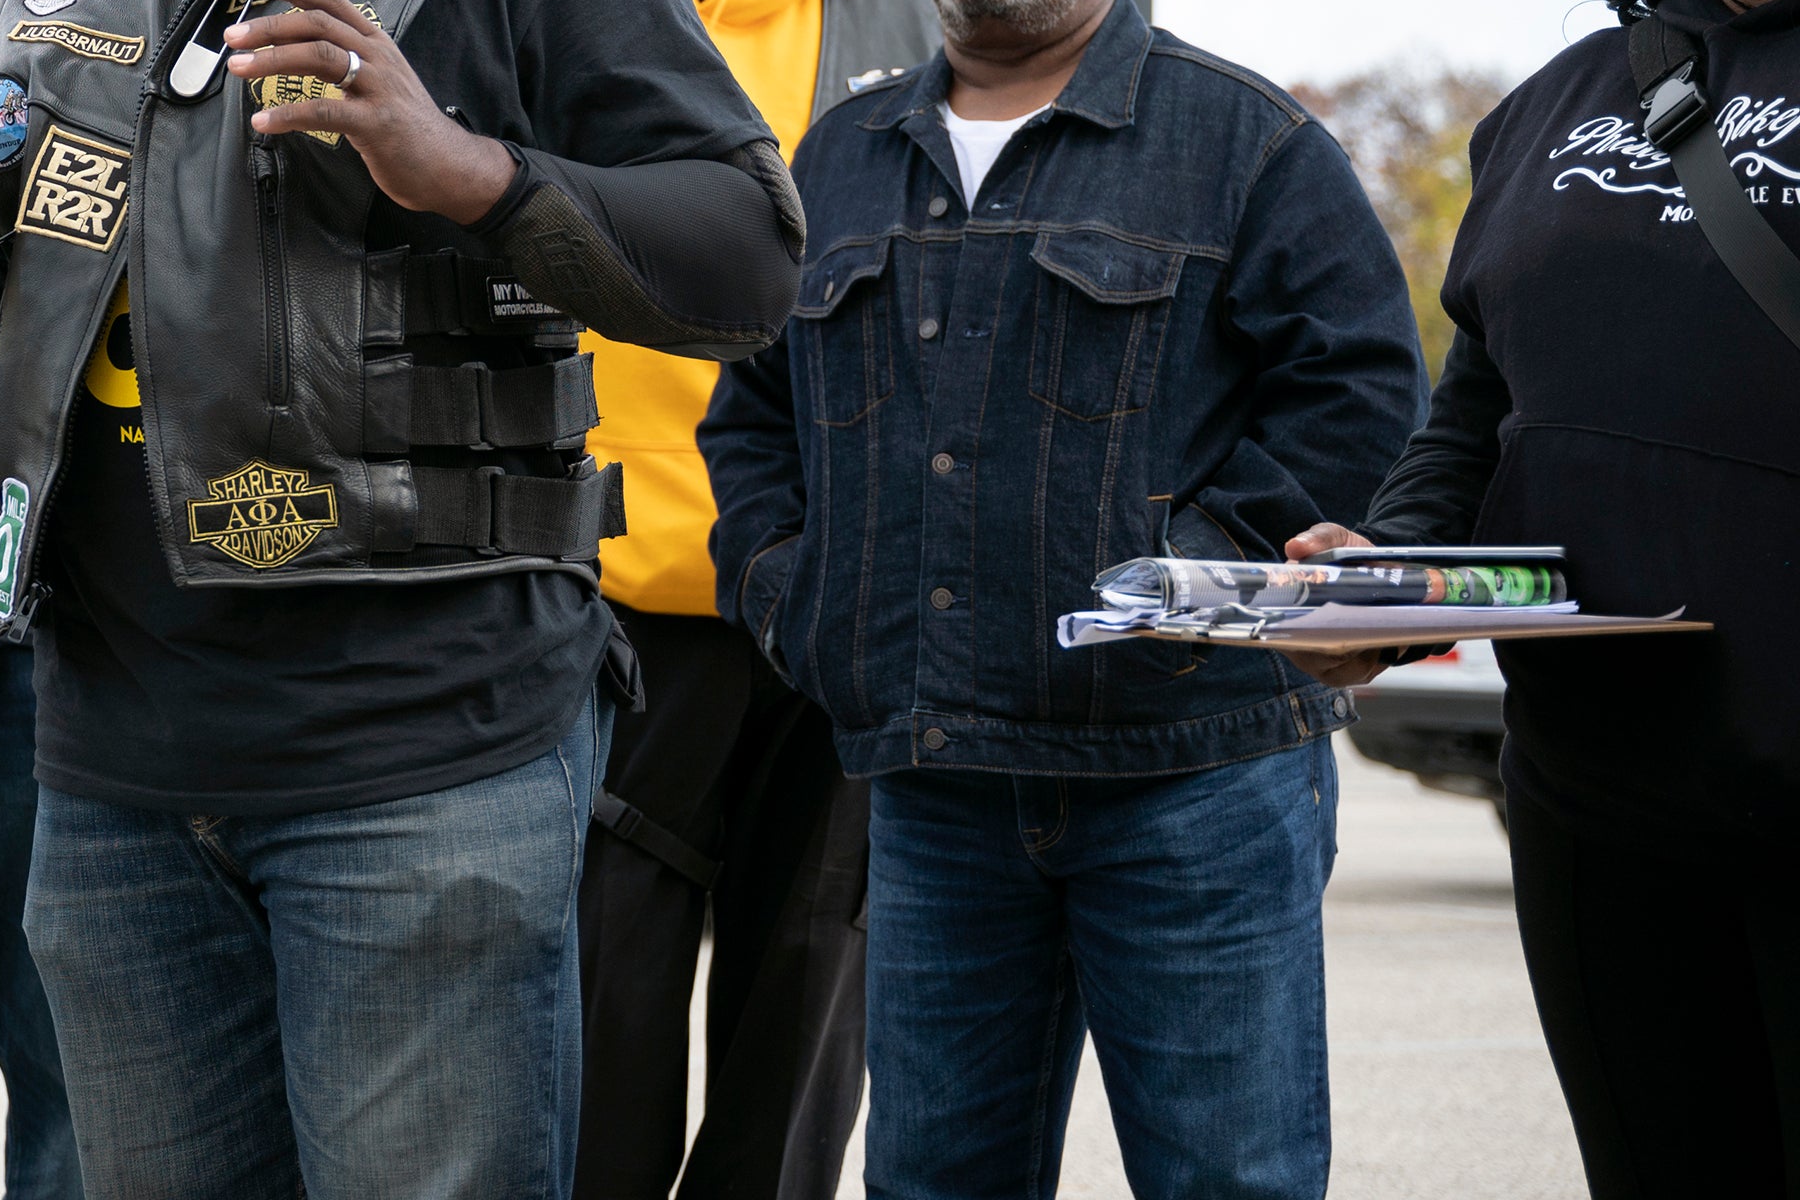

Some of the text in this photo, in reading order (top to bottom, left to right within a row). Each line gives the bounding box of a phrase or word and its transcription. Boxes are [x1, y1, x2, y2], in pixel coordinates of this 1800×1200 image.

[19, 25, 137, 59] JUGG3RNAUT
[39, 141, 128, 200] E2L
[25, 179, 114, 238] R2R
[492, 283, 512, 301] MY
[493, 302, 543, 316] MOTORCYCLES
[224, 469, 296, 499] HARLEY
[5, 494, 27, 521] MILE
[231, 525, 303, 561] DAVIDSON
